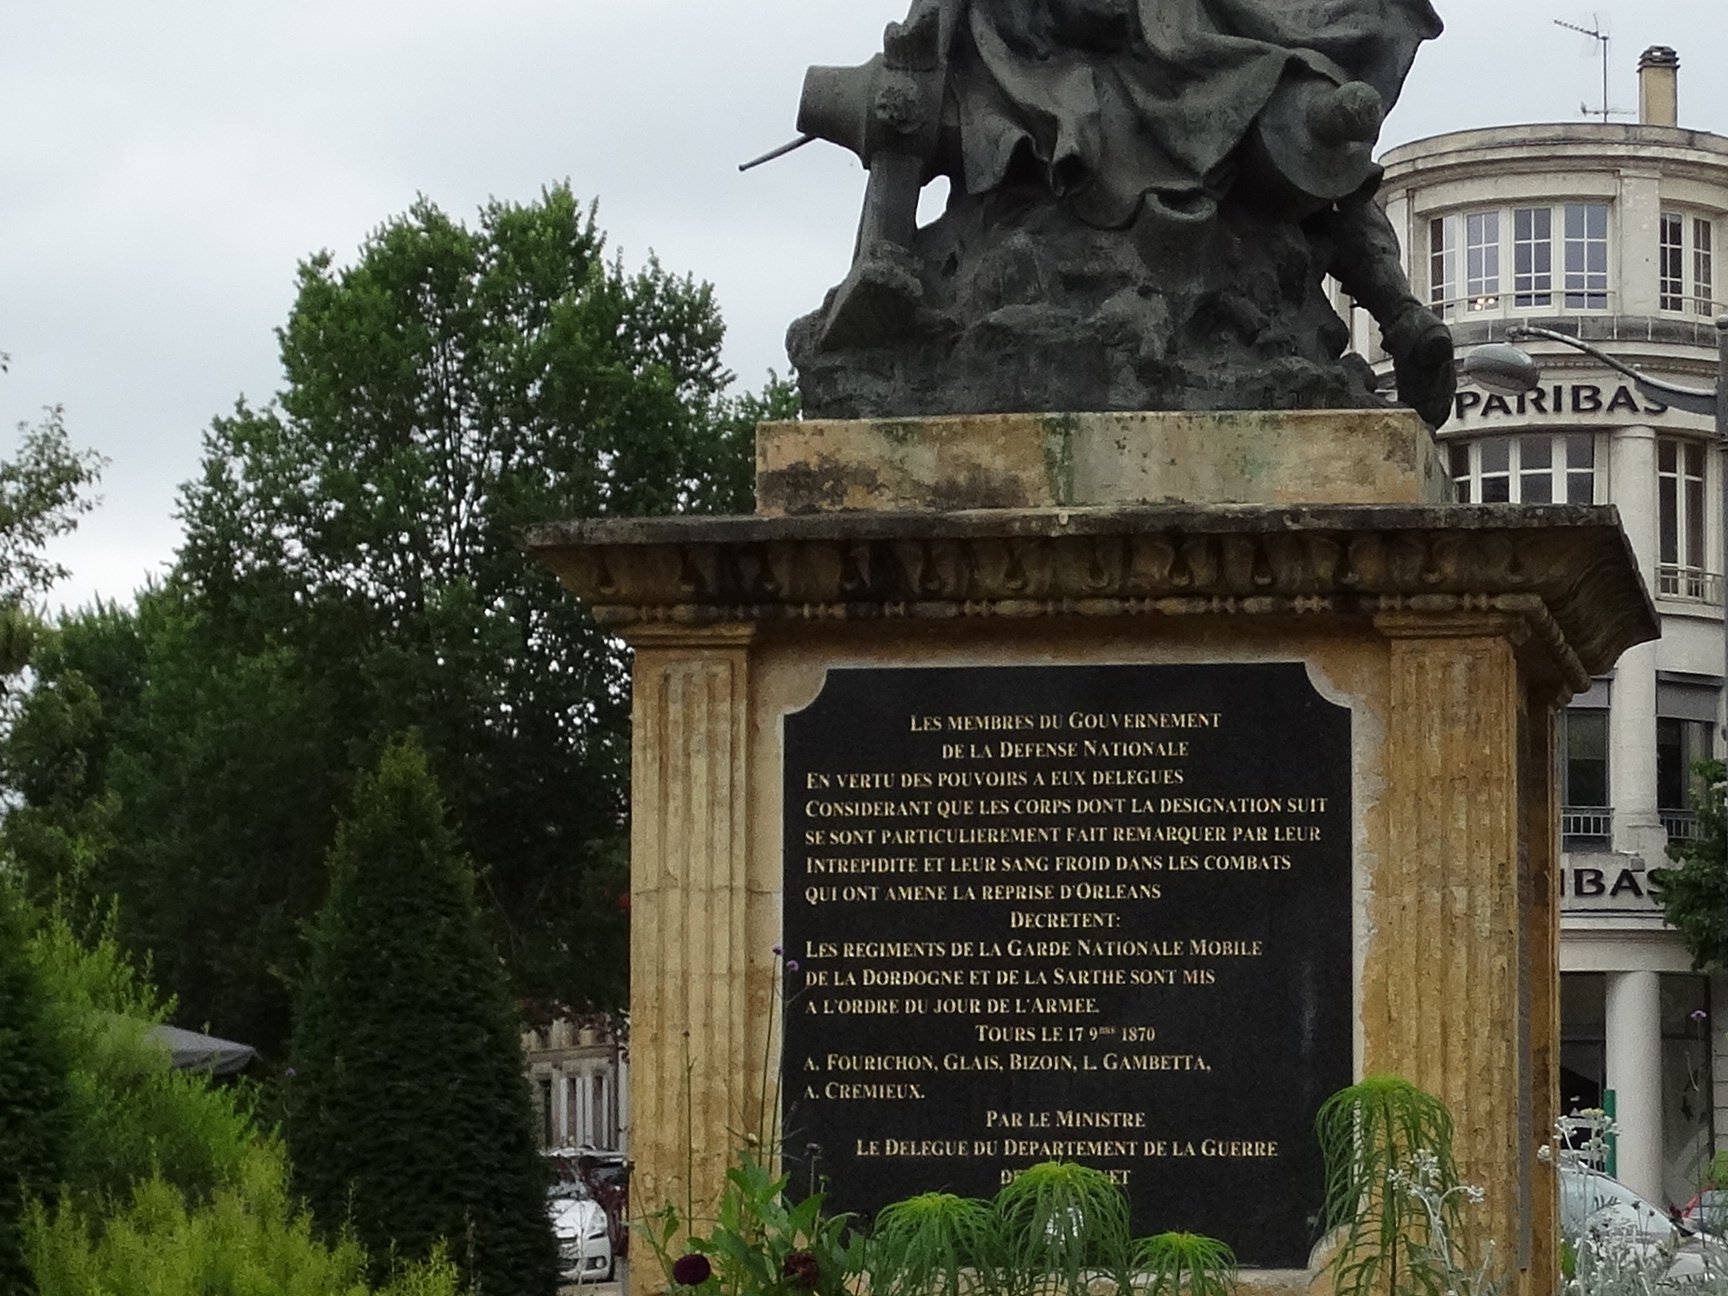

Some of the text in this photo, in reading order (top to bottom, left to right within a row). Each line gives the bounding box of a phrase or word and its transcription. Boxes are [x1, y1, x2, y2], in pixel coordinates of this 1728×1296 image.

[910, 711, 1222, 732] LES MEMBRES DU GOUVERNEMENT
[942, 739, 1189, 760] DE LA DEFENSE NATIONALE
[806, 769, 1184, 790] EN VERTU DES POUVOIRS A EUX DELEGUES
[805, 797, 1328, 819] CONSIDERANT QUE LES CORPS DONT LA DESIGNATION SUIT
[805, 826, 1321, 846] SE SONT PARTICULIEREMENT FAIT REMARQUER PAR LEUR
[806, 854, 1292, 874] INTREPIDITE ET LEUR SANG FROID DANS LES COMBATS
[804, 882, 1162, 906] QUI ONT AMENE LA REPRISE D'ORLEANS
[1010, 911, 1121, 929] DECRETENT:
[805, 938, 1263, 959] LES REGIMENTS DE LA GARDE NATIONALE MOBILE
[805, 967, 1216, 987] DE LA DORDOGNE ET DE LA SARTHE SONT MIS
[805, 1000, 818, 1015] A
[823, 998, 900, 1014] L'ORDRE
[904, 999, 928, 1015] DU
[933, 998, 982, 1014] JOUR
[987, 998, 1010, 1014] DE
[974, 1024, 1036, 1042] TOURS
[1041, 1026, 1063, 1042] LE
[1068, 1026, 1084, 1042] 17
[1121, 1026, 1156, 1042] 1870
[803, 1056, 820, 1071] A.
[827, 1053, 939, 1072] FOURICHON,
[1009, 1053, 1078, 1073] BIZOIN,
[1083, 1055, 1098, 1071] L.
[1102, 1052, 1212, 1072] GAMBETTA,
[804, 1081, 925, 1100] A. CREMIEUX.
[986, 1110, 1146, 1128] PAR LE MINISTRE
[856, 1138, 1278, 1157] LE DELEGUE DU DEPARTEMENT DE LA GUERRE
